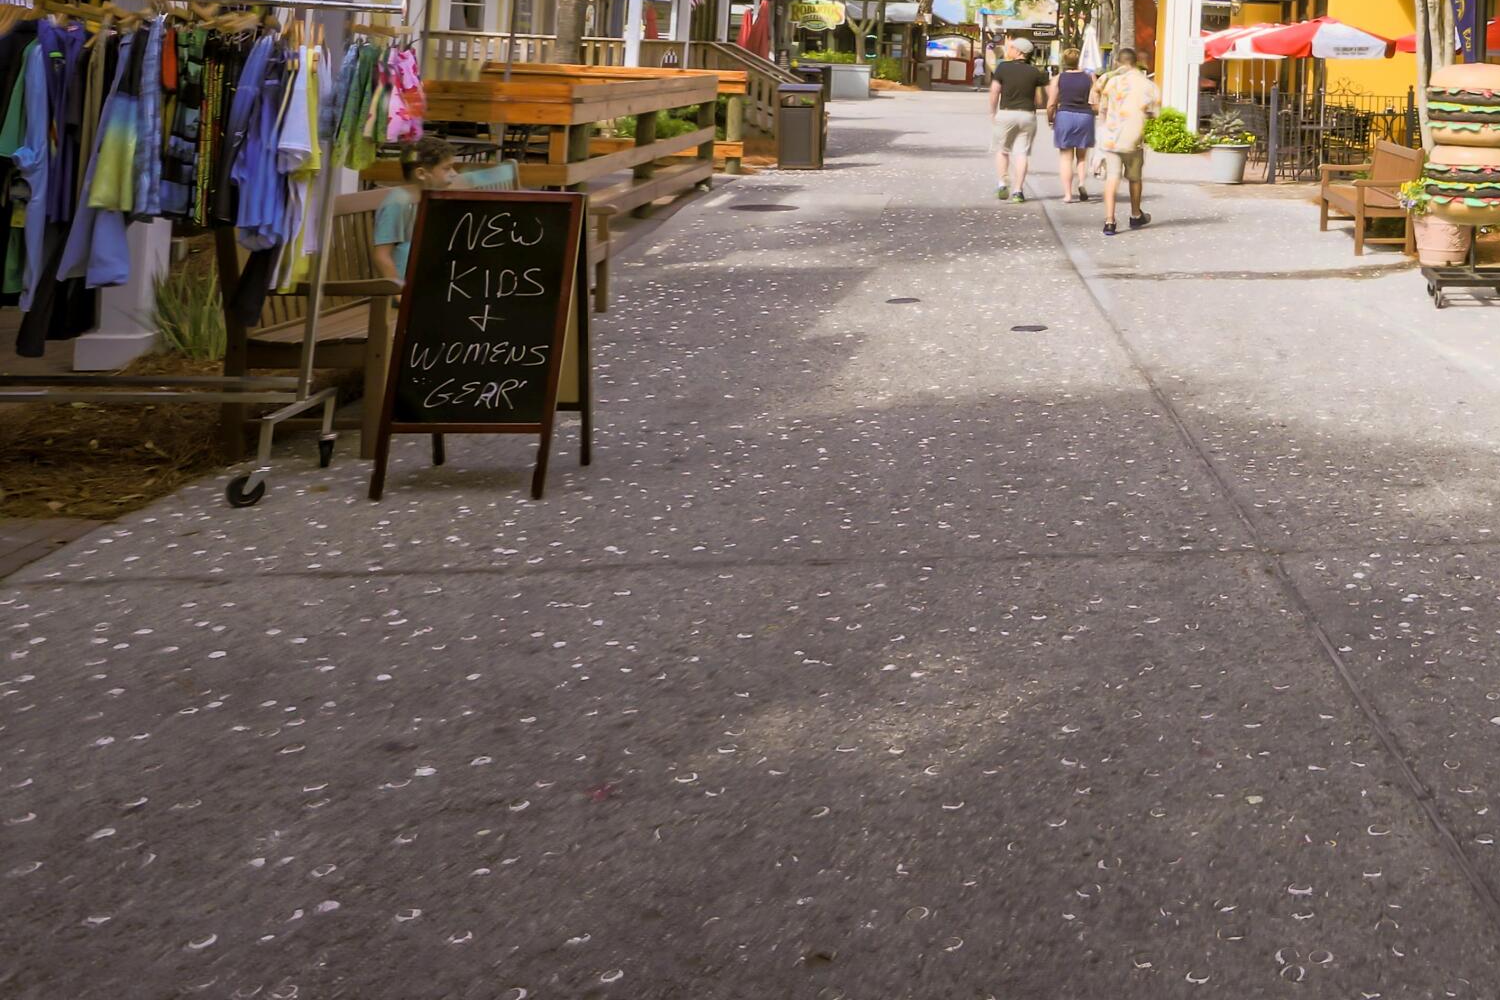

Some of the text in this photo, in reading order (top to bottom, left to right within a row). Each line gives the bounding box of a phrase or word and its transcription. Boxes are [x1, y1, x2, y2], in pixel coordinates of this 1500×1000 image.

[447, 211, 545, 252] NEW
[447, 260, 545, 303] KIDS
[409, 341, 549, 371] WOMENS
